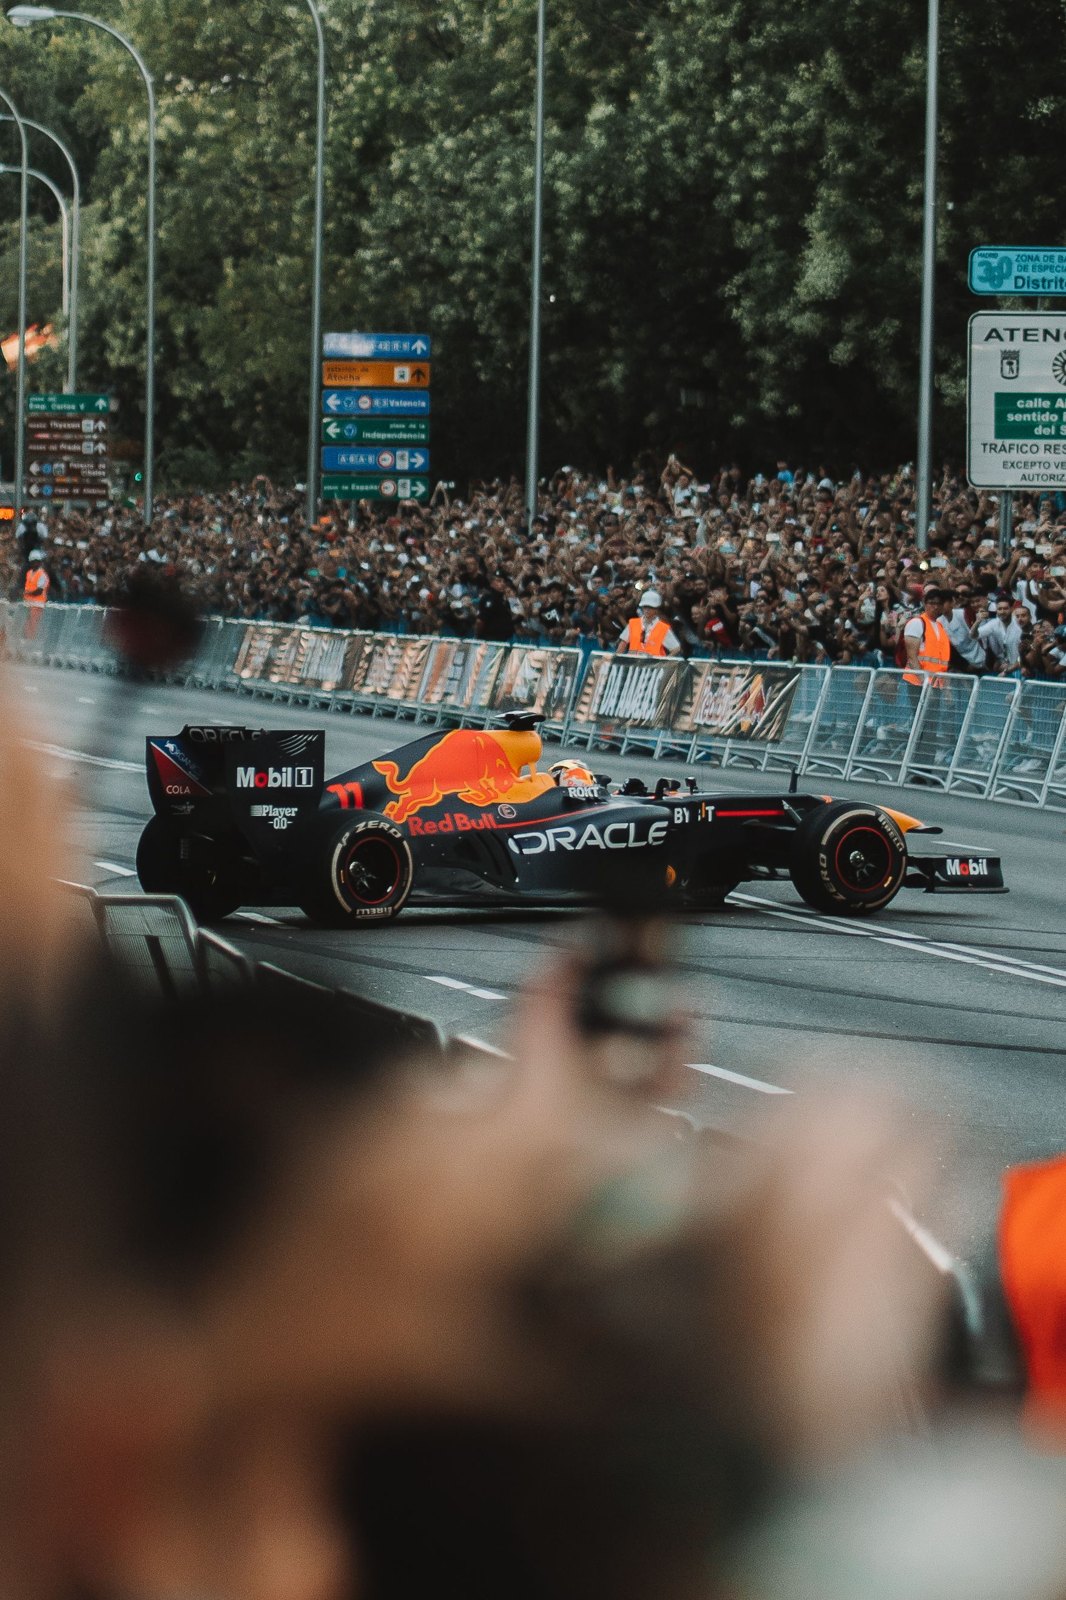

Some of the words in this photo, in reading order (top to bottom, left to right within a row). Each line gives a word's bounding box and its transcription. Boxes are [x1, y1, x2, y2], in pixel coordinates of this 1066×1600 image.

[1015, 254, 1039, 262] ZONA
[1042, 254, 1054, 263] DE
[1016, 264, 1028, 272] DE
[983, 327, 1066, 342] ATEN
[390, 399, 426, 408] Valencia
[1016, 397, 1051, 408] calle
[1055, 397, 1066, 408] A
[1006, 411, 1058, 421] sentido
[362, 431, 426, 440] Independencia
[1034, 424, 1055, 435] del
[980, 441, 1039, 454] TRÁFICO
[1002, 460, 1051, 469] EXCEPTO
[1020, 473, 1066, 482] AUTORIZ
[189, 727, 263, 743] ORCL
[236, 766, 292, 788] Mobil
[298, 768, 309, 786] 1
[165, 784, 191, 795] COLA
[326, 782, 363, 809] 11
[262, 804, 298, 818] Player
[355, 820, 402, 839] ZERO
[407, 815, 453, 837] Red
[455, 812, 499, 832] Bull
[508, 820, 669, 855] ORACLE
[946, 859, 988, 876] Mobil
